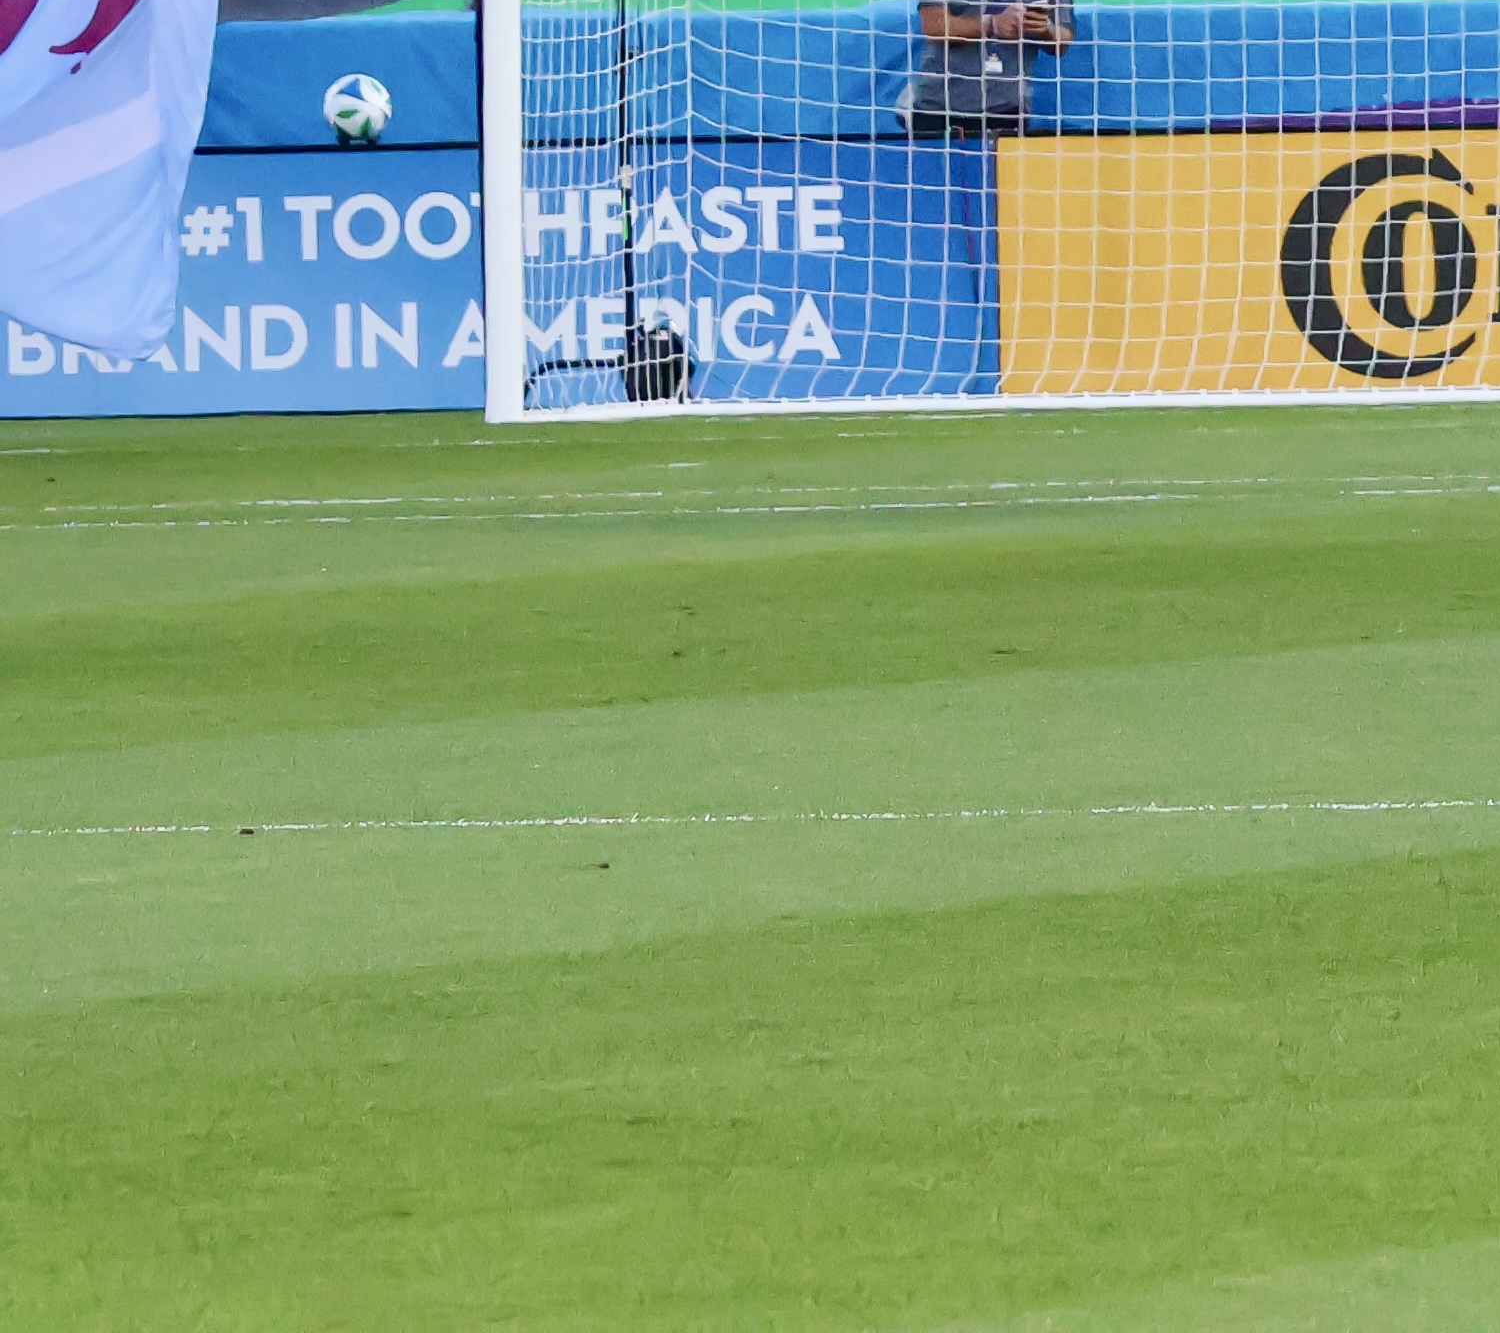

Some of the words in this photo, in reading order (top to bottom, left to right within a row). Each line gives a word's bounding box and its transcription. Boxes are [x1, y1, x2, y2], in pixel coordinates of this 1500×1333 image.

[183, 196, 262, 263] #1
[284, 186, 846, 263] TOOHPASTE
[336, 300, 418, 371] IN
